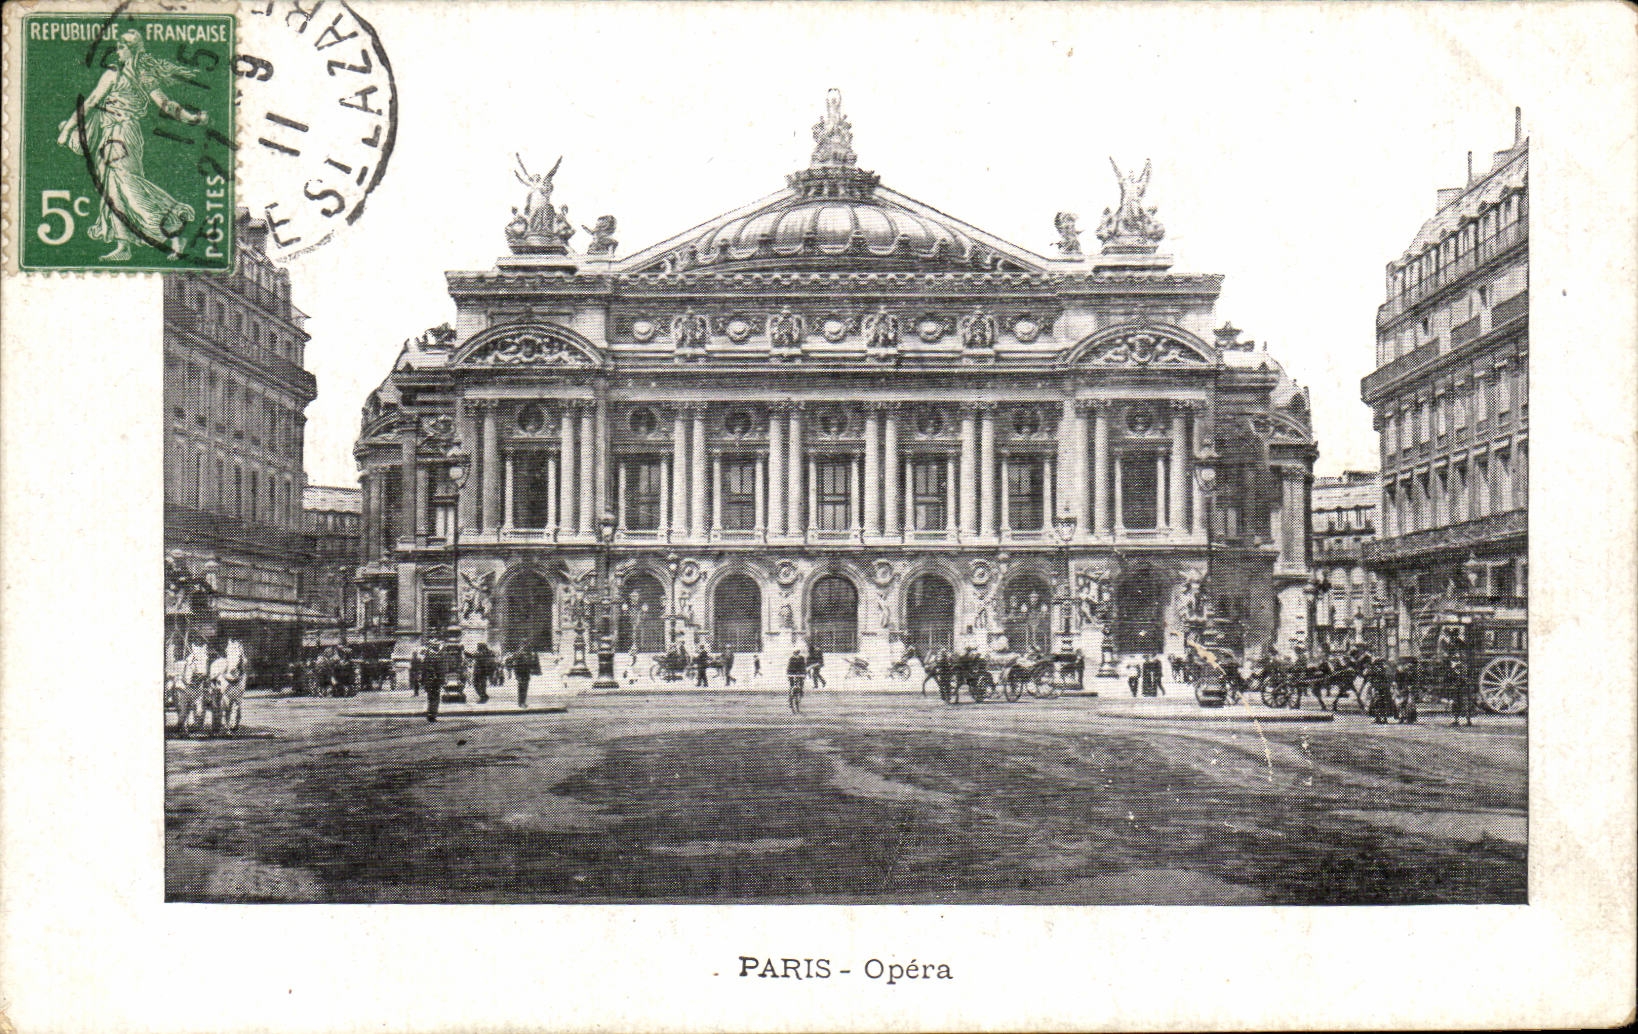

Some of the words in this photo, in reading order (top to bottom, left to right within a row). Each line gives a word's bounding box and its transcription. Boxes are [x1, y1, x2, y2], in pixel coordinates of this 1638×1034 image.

[145, 23, 227, 45] FRANÇAISE
[229, 54, 274, 82] 9
[204, 174, 225, 258] POSTES
